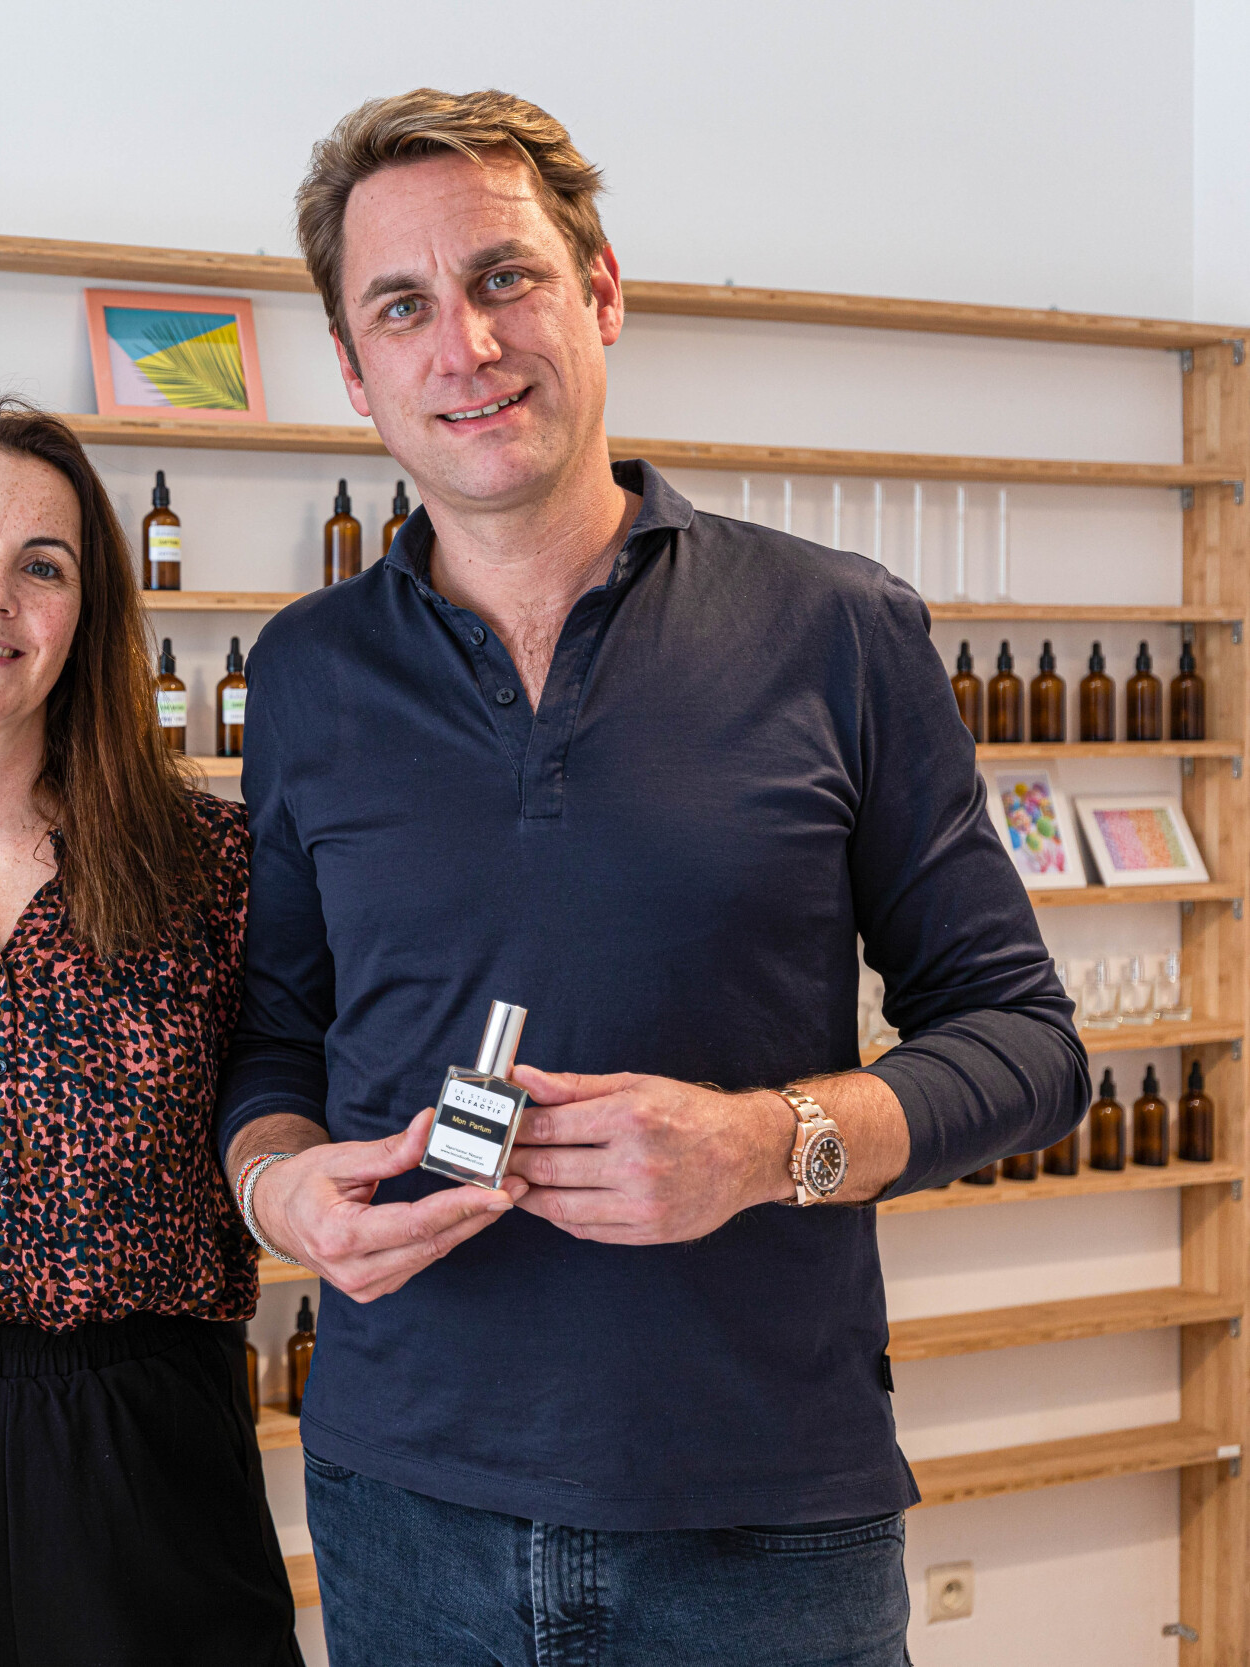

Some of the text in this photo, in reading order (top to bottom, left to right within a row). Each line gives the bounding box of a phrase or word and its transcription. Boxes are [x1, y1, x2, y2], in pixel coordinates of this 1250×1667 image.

[455, 1095, 501, 1115] OLFACTIF
[470, 1093, 506, 1109] STUDIO
[451, 1115, 492, 1135] Mon Parfum
